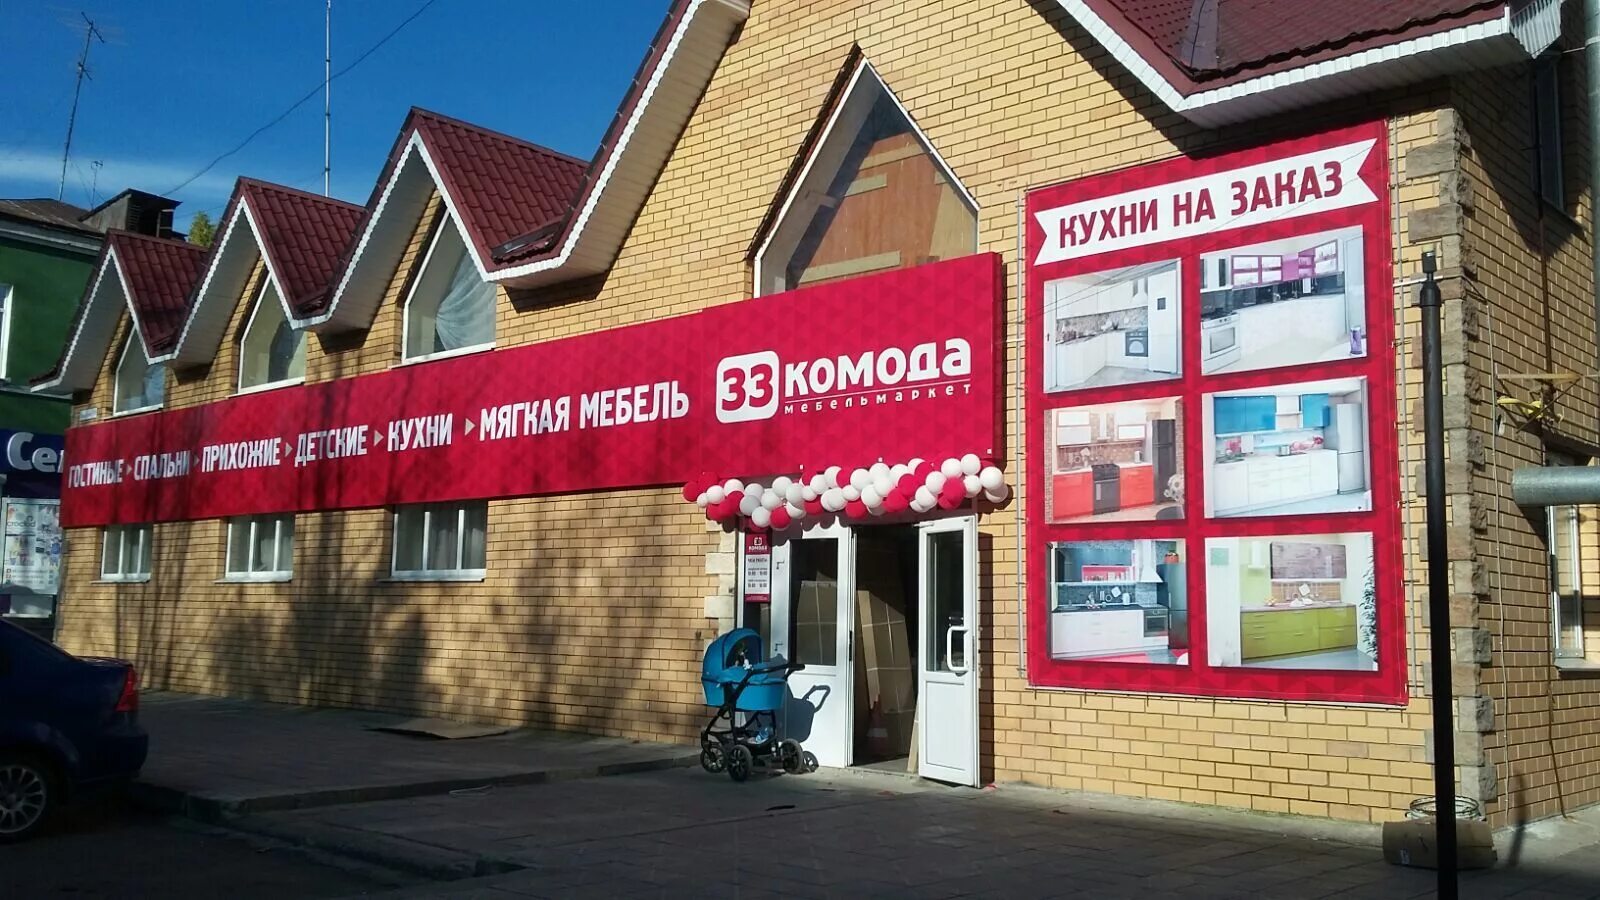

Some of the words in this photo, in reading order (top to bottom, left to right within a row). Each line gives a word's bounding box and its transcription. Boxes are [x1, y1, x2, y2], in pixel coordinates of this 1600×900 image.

[1059, 198, 1158, 249] КУХНИ
[1173, 188, 1216, 227] НА
[1231, 160, 1343, 216] ЗАКАЗ
[721, 363, 773, 411] 33
[784, 337, 971, 398] комода
[784, 383, 971, 415] мебельмаркет
[68, 459, 124, 488] ГОСТИНЫЕ
[133, 450, 190, 481] СПАЛЬНИ
[201, 437, 282, 473] ПРИХОЖИЕ
[294, 425, 368, 467] ДЕТСКИЕ
[387, 413, 453, 452] КУХНИ
[479, 395, 571, 441] МЯГКАЯ
[579, 380, 689, 429] МЕБЕЛЬ
